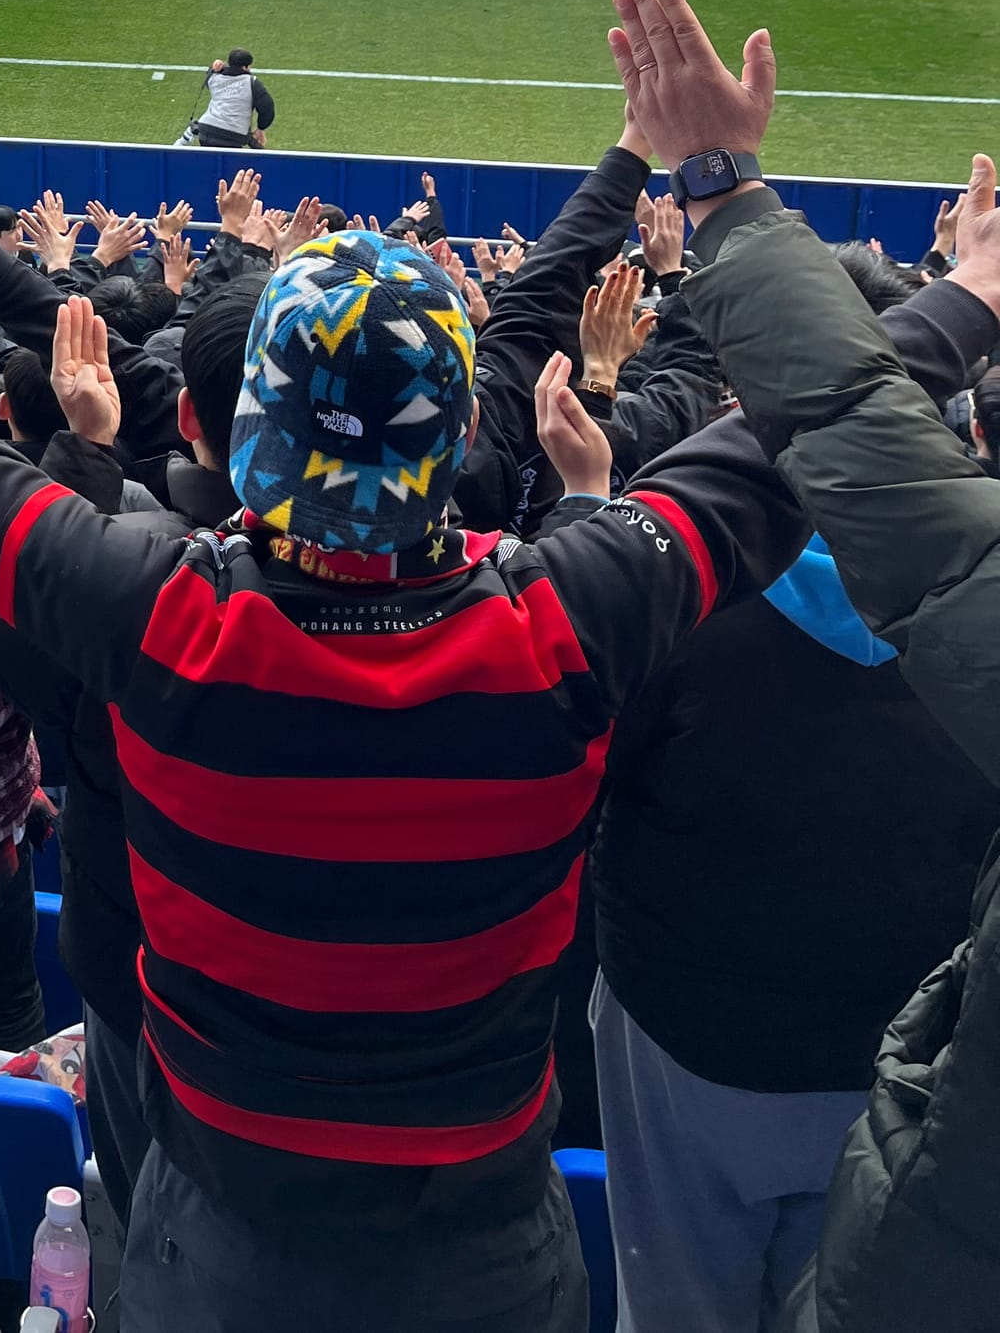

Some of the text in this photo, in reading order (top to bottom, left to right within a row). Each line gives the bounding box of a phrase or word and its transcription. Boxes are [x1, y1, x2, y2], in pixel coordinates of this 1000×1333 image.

[316, 411, 348, 426] NORTH
[323, 420, 347, 434] FACE
[300, 621, 363, 631] POHANG
